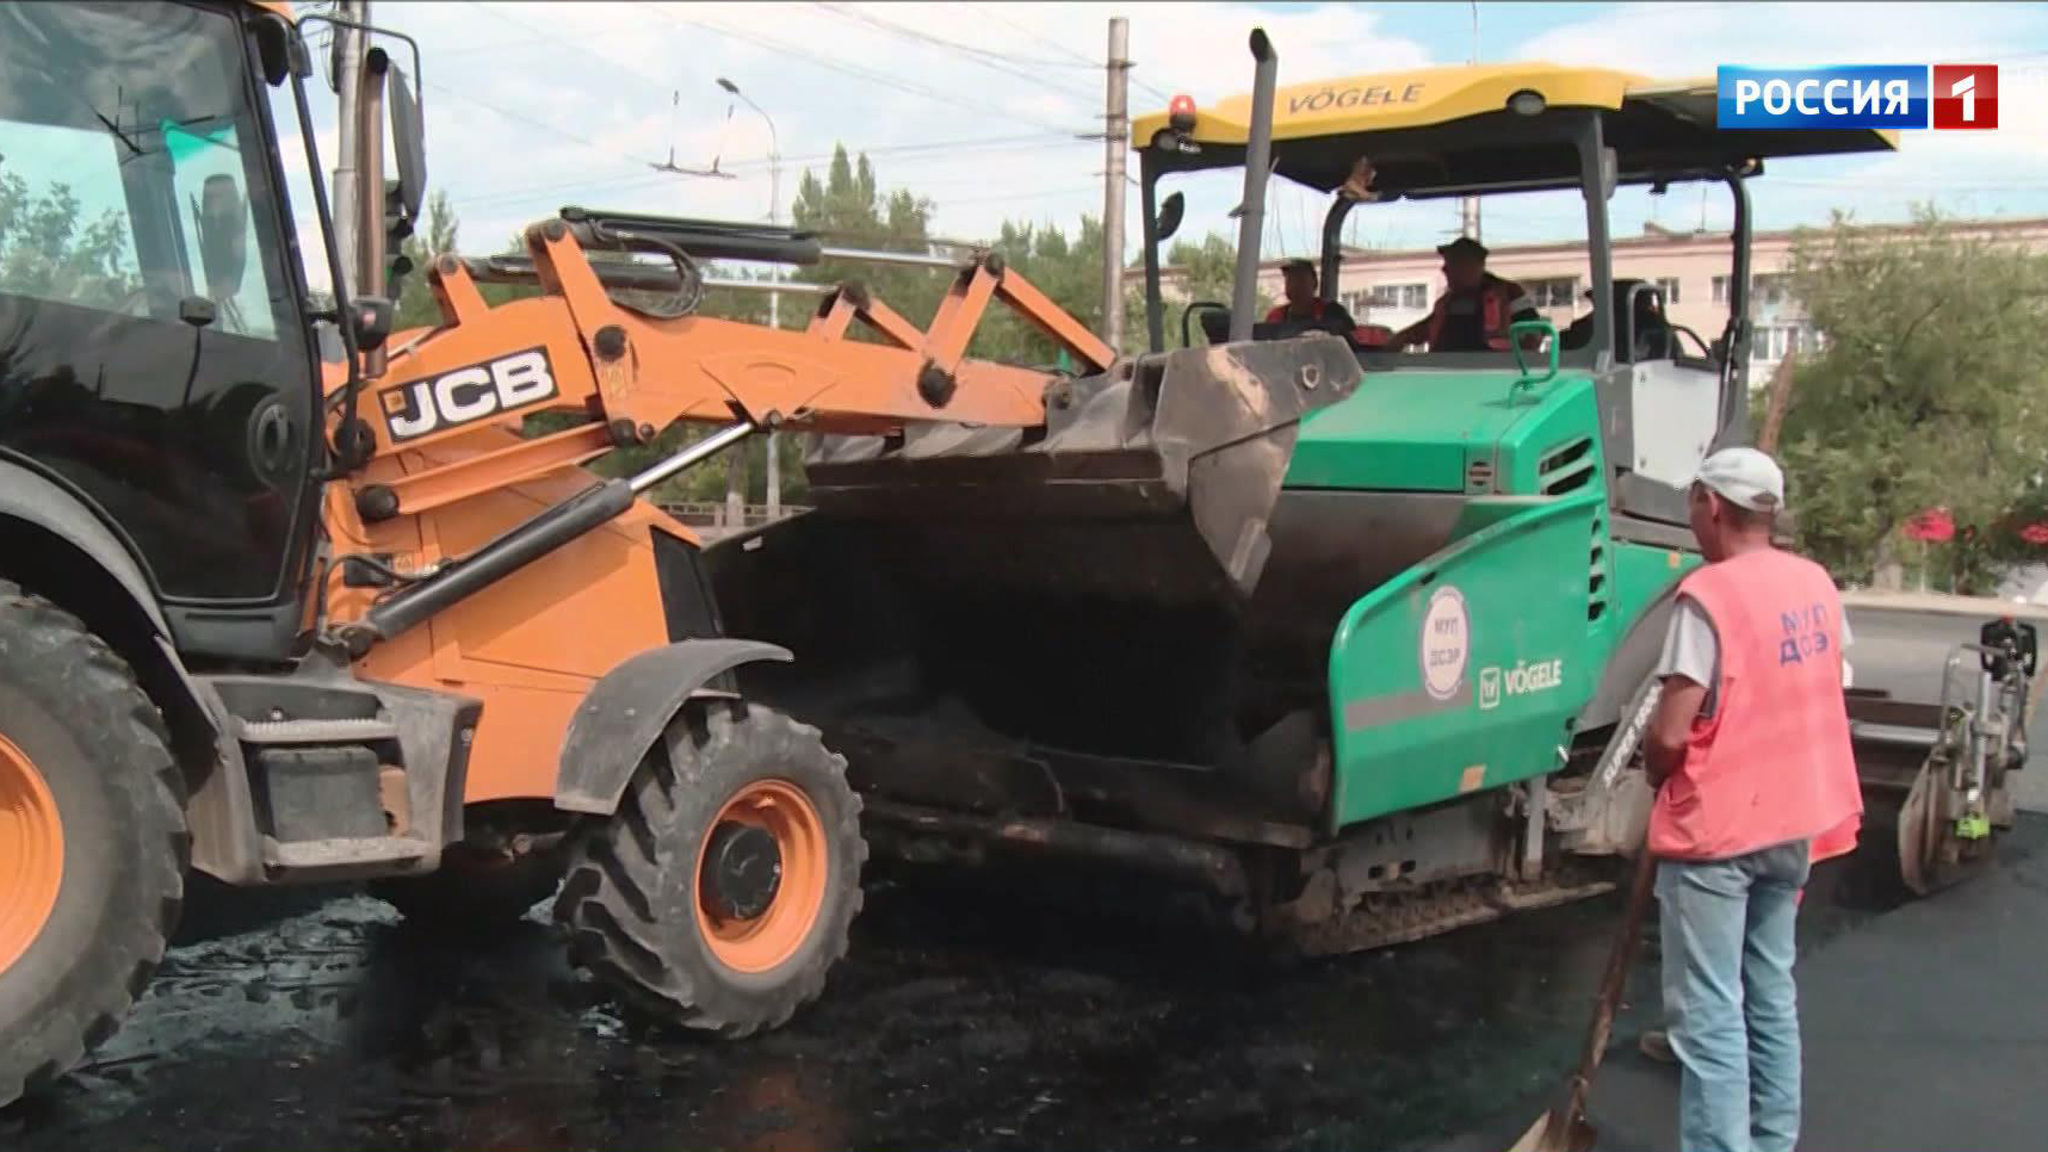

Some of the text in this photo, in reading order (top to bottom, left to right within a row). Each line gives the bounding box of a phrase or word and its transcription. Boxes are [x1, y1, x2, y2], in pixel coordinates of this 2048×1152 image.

[1289, 83, 1426, 114] VÖGELE
[390, 351, 554, 437] JCB
[1504, 659, 1562, 695] VÖGELE
